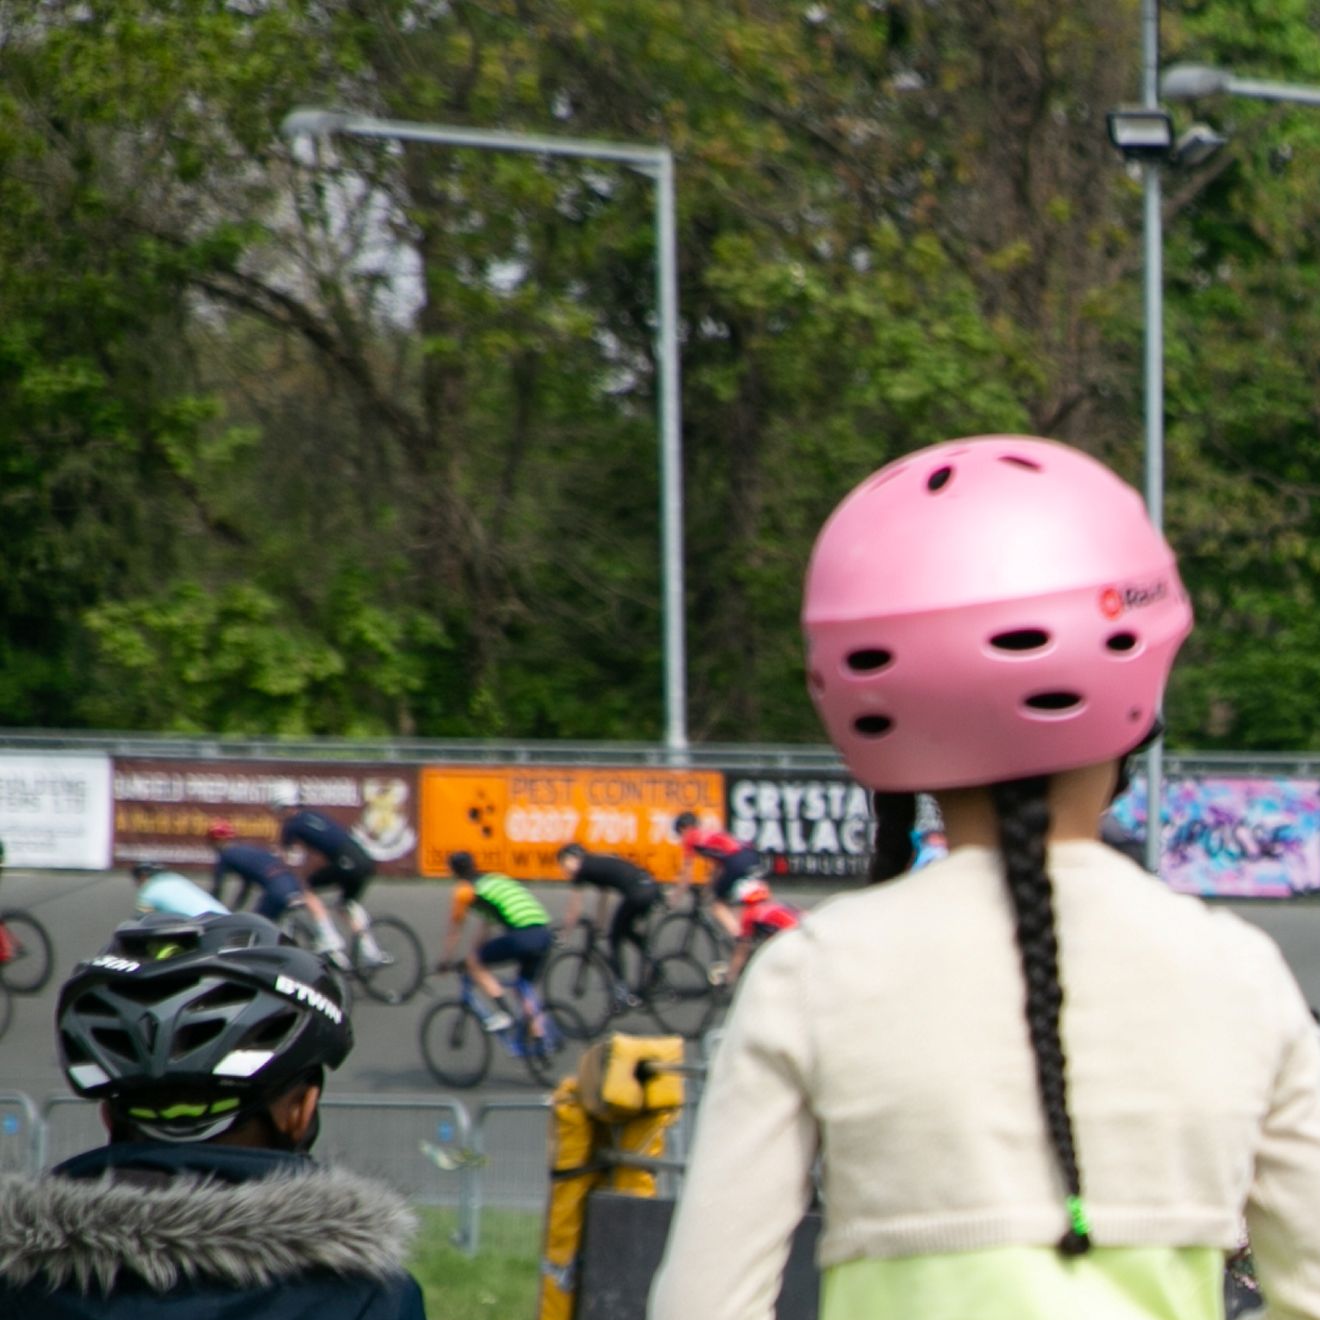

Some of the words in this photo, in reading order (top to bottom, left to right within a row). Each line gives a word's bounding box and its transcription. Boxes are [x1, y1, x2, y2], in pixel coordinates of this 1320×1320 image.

[511, 776, 574, 801] PEST
[587, 777, 721, 807] CONTROL
[731, 779, 877, 820] CRYSTA
[505, 806, 579, 843] 0207
[587, 809, 638, 844] 701
[274, 974, 342, 1024] BTWIN
